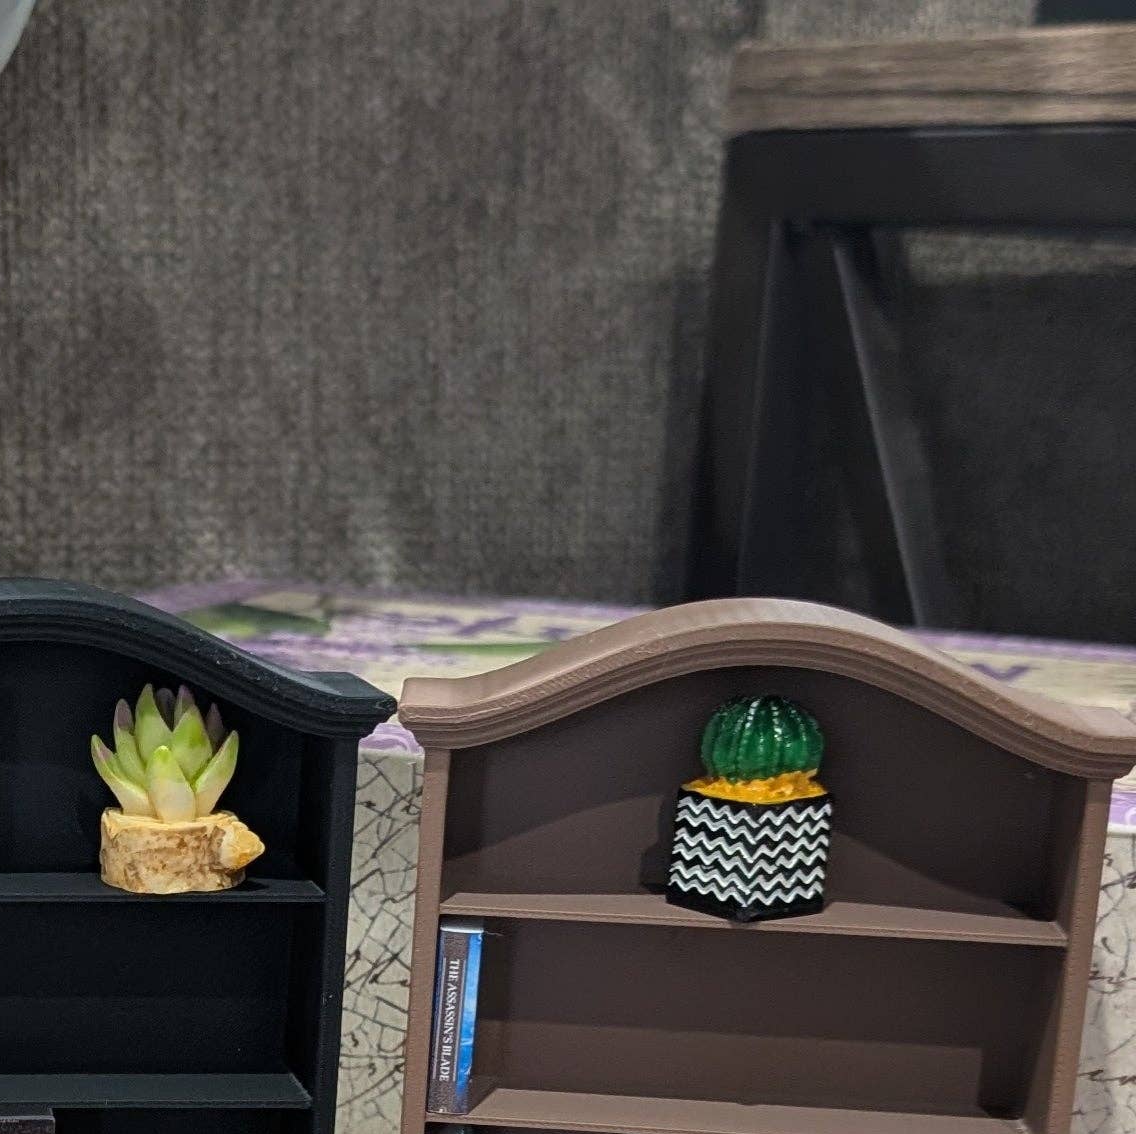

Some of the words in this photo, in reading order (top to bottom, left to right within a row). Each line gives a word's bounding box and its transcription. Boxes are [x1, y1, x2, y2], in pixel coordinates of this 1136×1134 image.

[449, 959, 460, 984] THE
[443, 983, 458, 1045] ASSASSIN'S
[439, 1044, 451, 1081] BLADE
